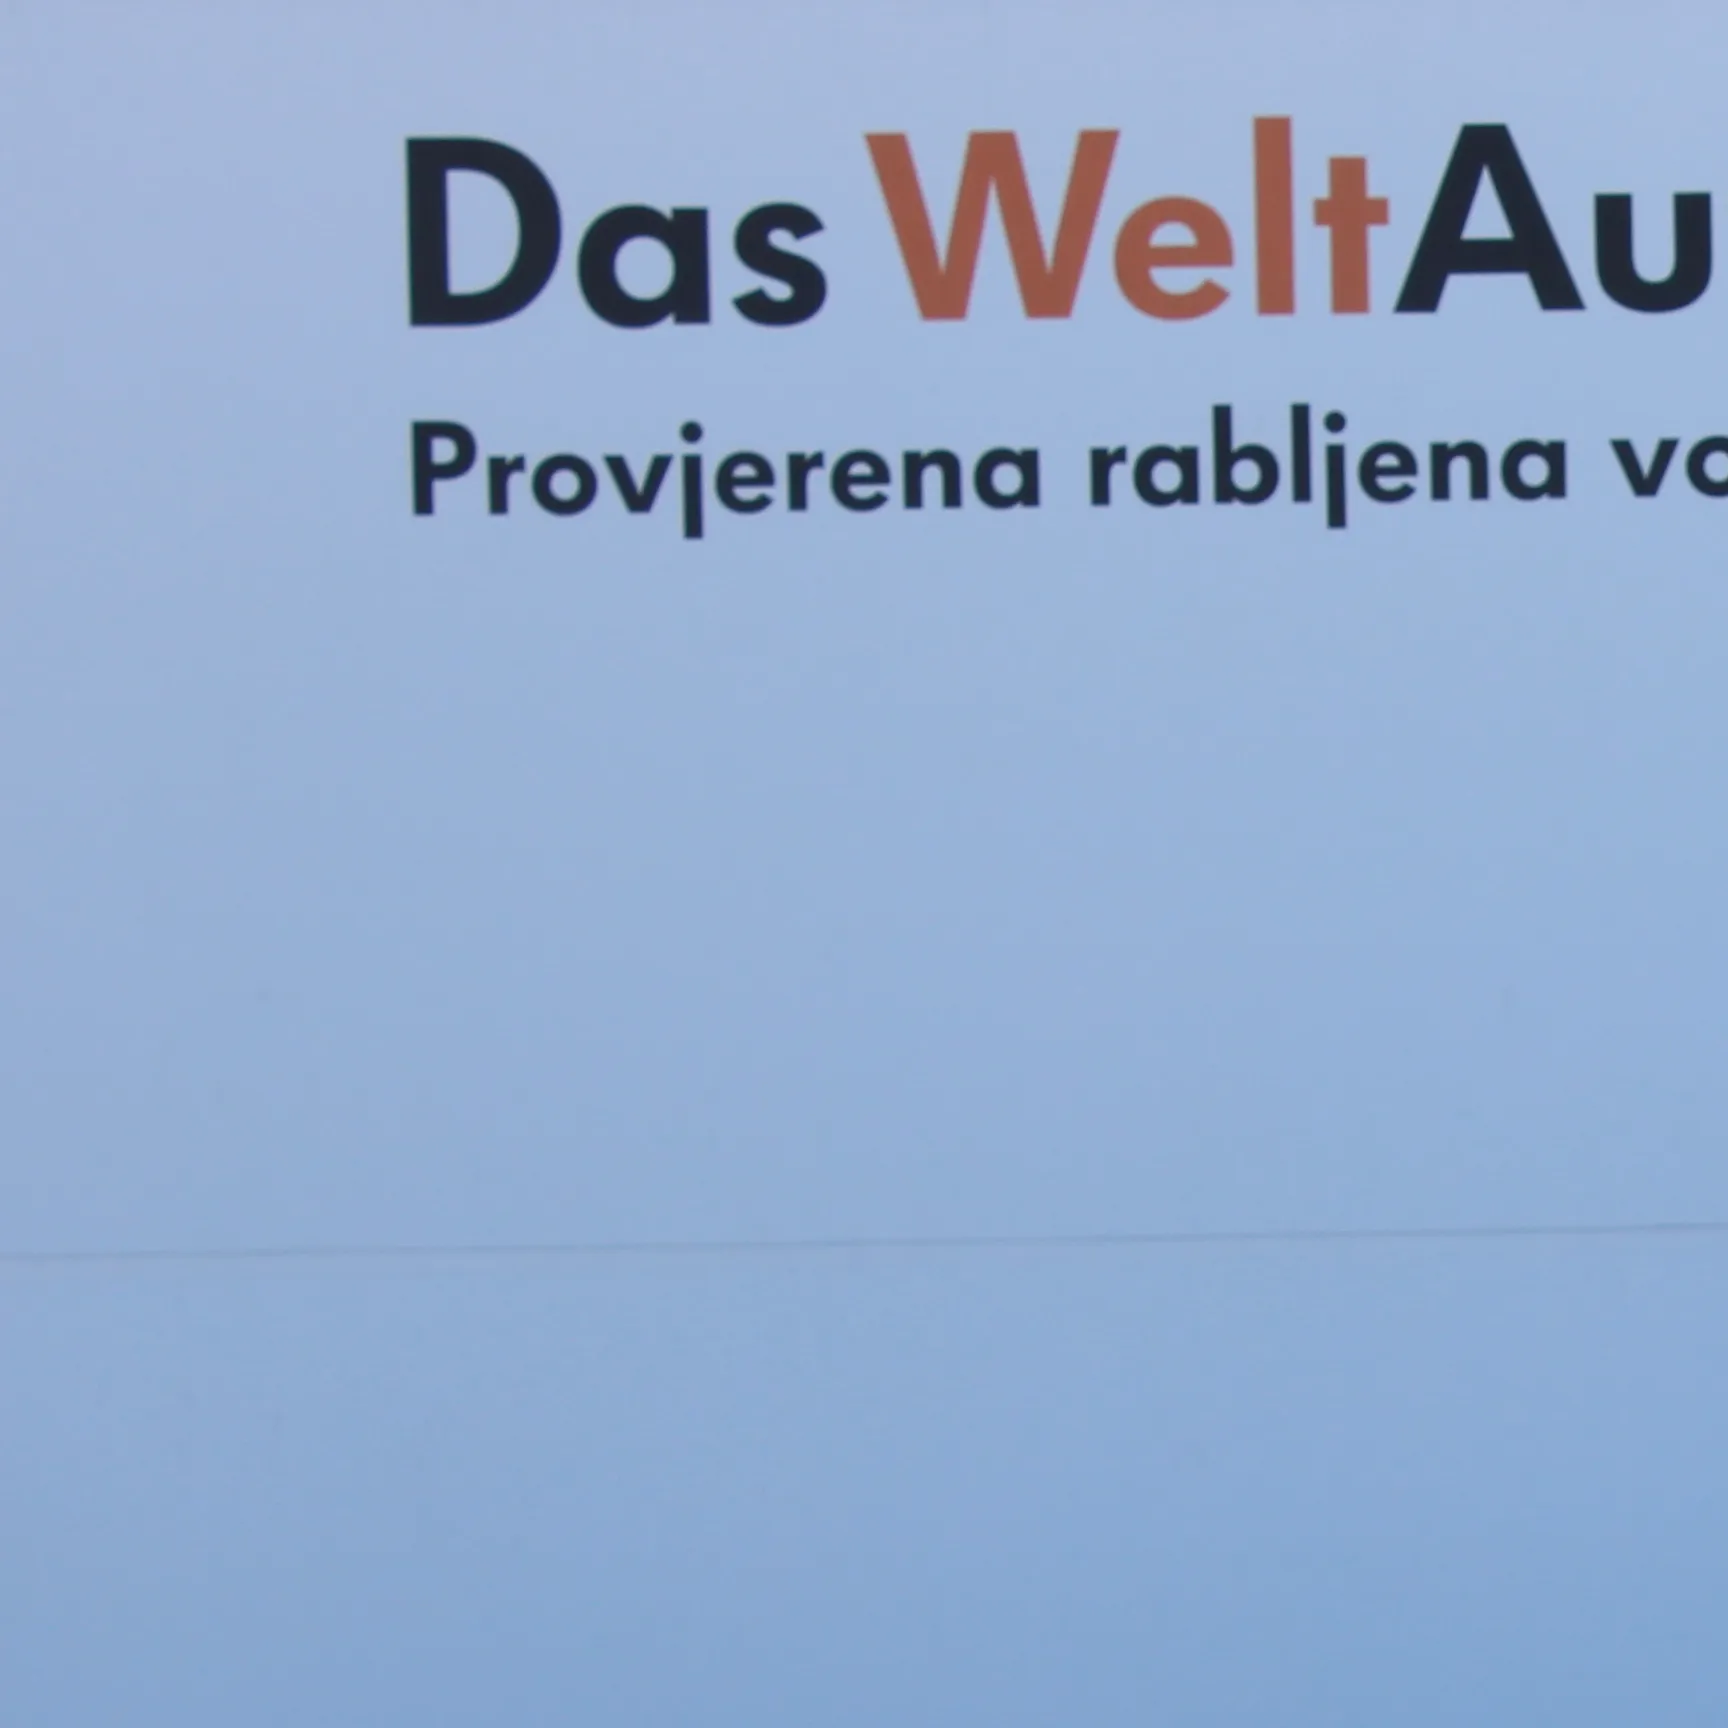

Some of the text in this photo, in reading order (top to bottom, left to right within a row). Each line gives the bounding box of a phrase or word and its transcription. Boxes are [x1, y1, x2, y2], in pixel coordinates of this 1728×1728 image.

[405, 136, 826, 327] Das
[411, 420, 1041, 540] Provjerena
[1090, 403, 1567, 530] rabljena
